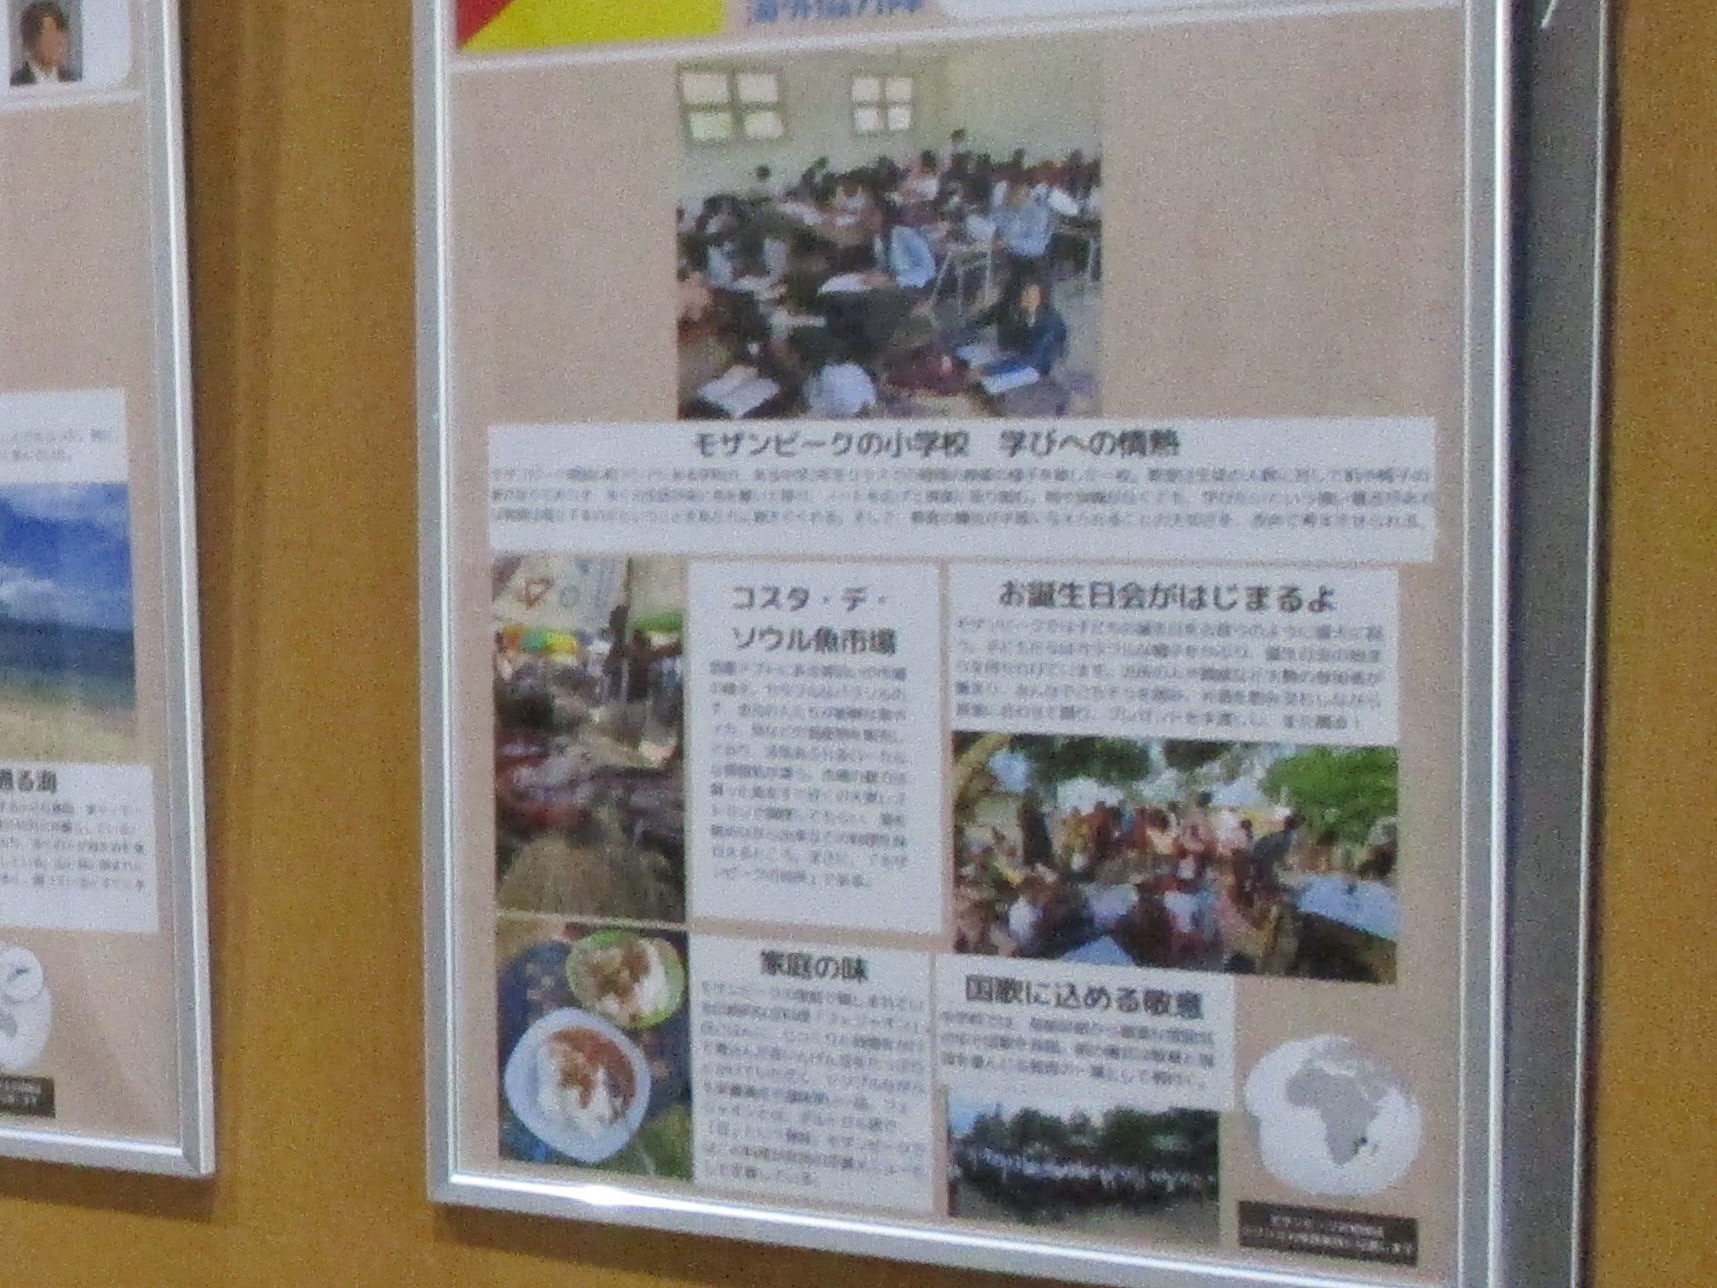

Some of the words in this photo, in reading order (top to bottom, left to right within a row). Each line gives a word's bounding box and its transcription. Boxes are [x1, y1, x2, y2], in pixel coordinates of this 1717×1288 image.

[694, 428, 971, 460] モザンビークの小学校
[998, 579, 1338, 612] お誕生日会がはじまるよ
[761, 949, 869, 984] 家庭の味
